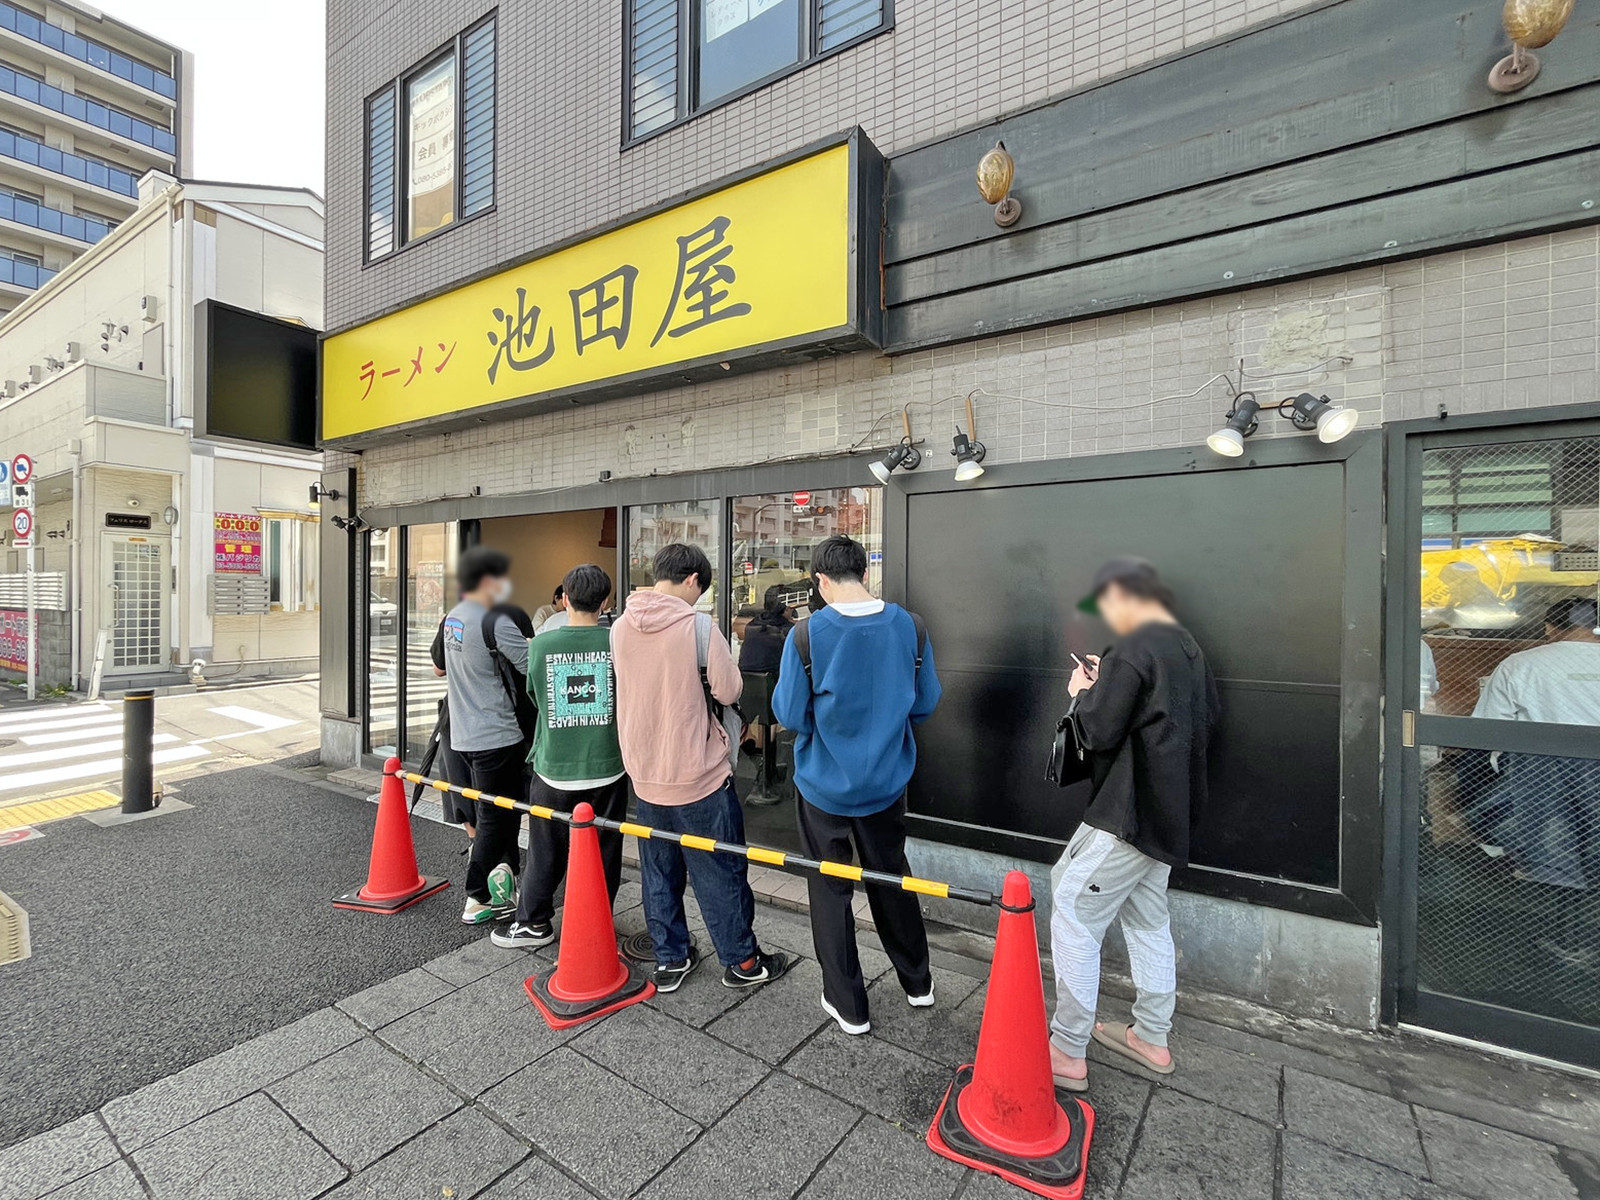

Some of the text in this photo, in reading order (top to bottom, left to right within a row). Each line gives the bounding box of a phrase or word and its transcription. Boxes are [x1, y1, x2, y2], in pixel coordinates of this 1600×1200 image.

[418, 142, 437, 161] 会員
[359, 216, 752, 401] ラーメン 池田屋
[16, 517, 28, 530] 20
[553, 651, 607, 665] STAY IN HEAD
[556, 716, 579, 729] HEAD
[579, 716, 588, 727] IN
[589, 714, 609, 726] STAY
